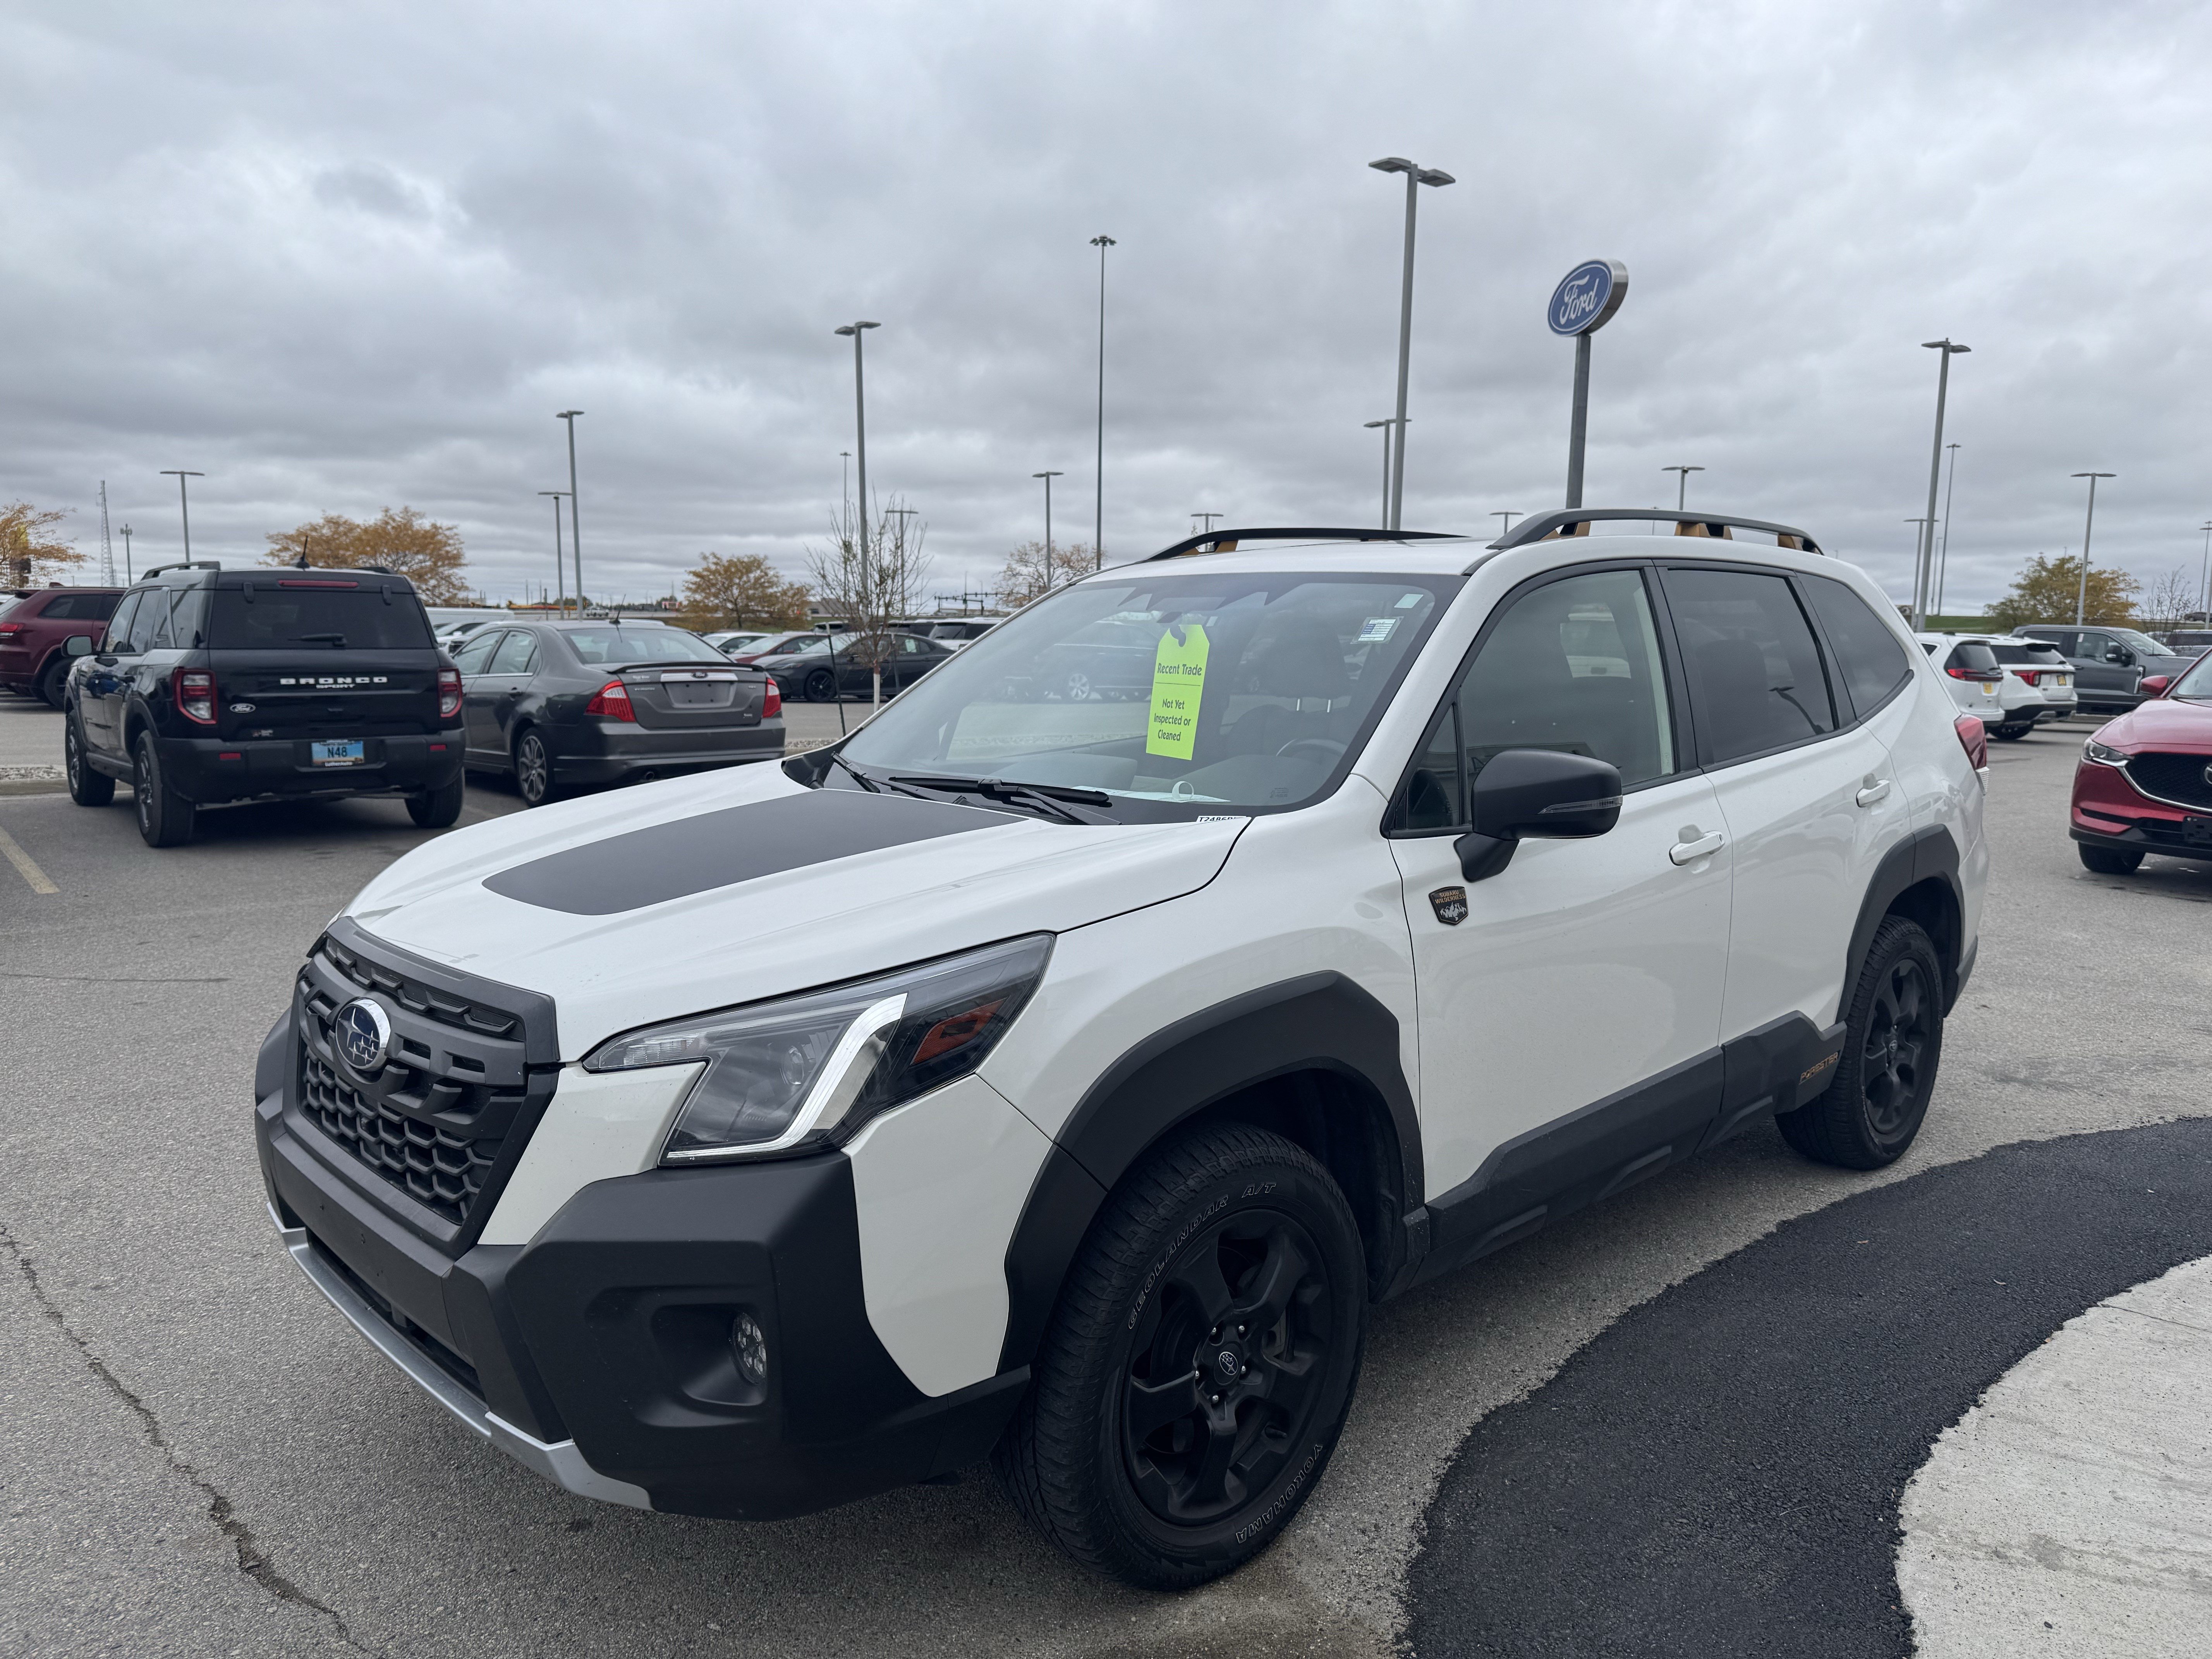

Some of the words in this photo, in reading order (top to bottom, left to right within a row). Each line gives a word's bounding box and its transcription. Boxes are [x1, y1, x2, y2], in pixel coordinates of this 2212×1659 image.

[1559, 274, 1599, 325] Ford
[1157, 663, 1180, 675] Recent
[1182, 664, 1202, 676] Trade
[280, 677, 387, 685] BRONCO
[1162, 698, 1173, 709] Not
[1175, 699, 1185, 709] Yet
[1154, 713, 1182, 725] Inspected
[1158, 729, 1181, 741] Cleaned
[328, 747, 347, 758] N48
[1434, 893, 1466, 904] WILDERNESS
[1800, 1052, 1838, 1082] FORESTER
[1128, 1194, 1228, 1329] GEOLANDAR
[1242, 1183, 1277, 1198] A/T
[1236, 1444, 1323, 1544] YOKOHAMA
